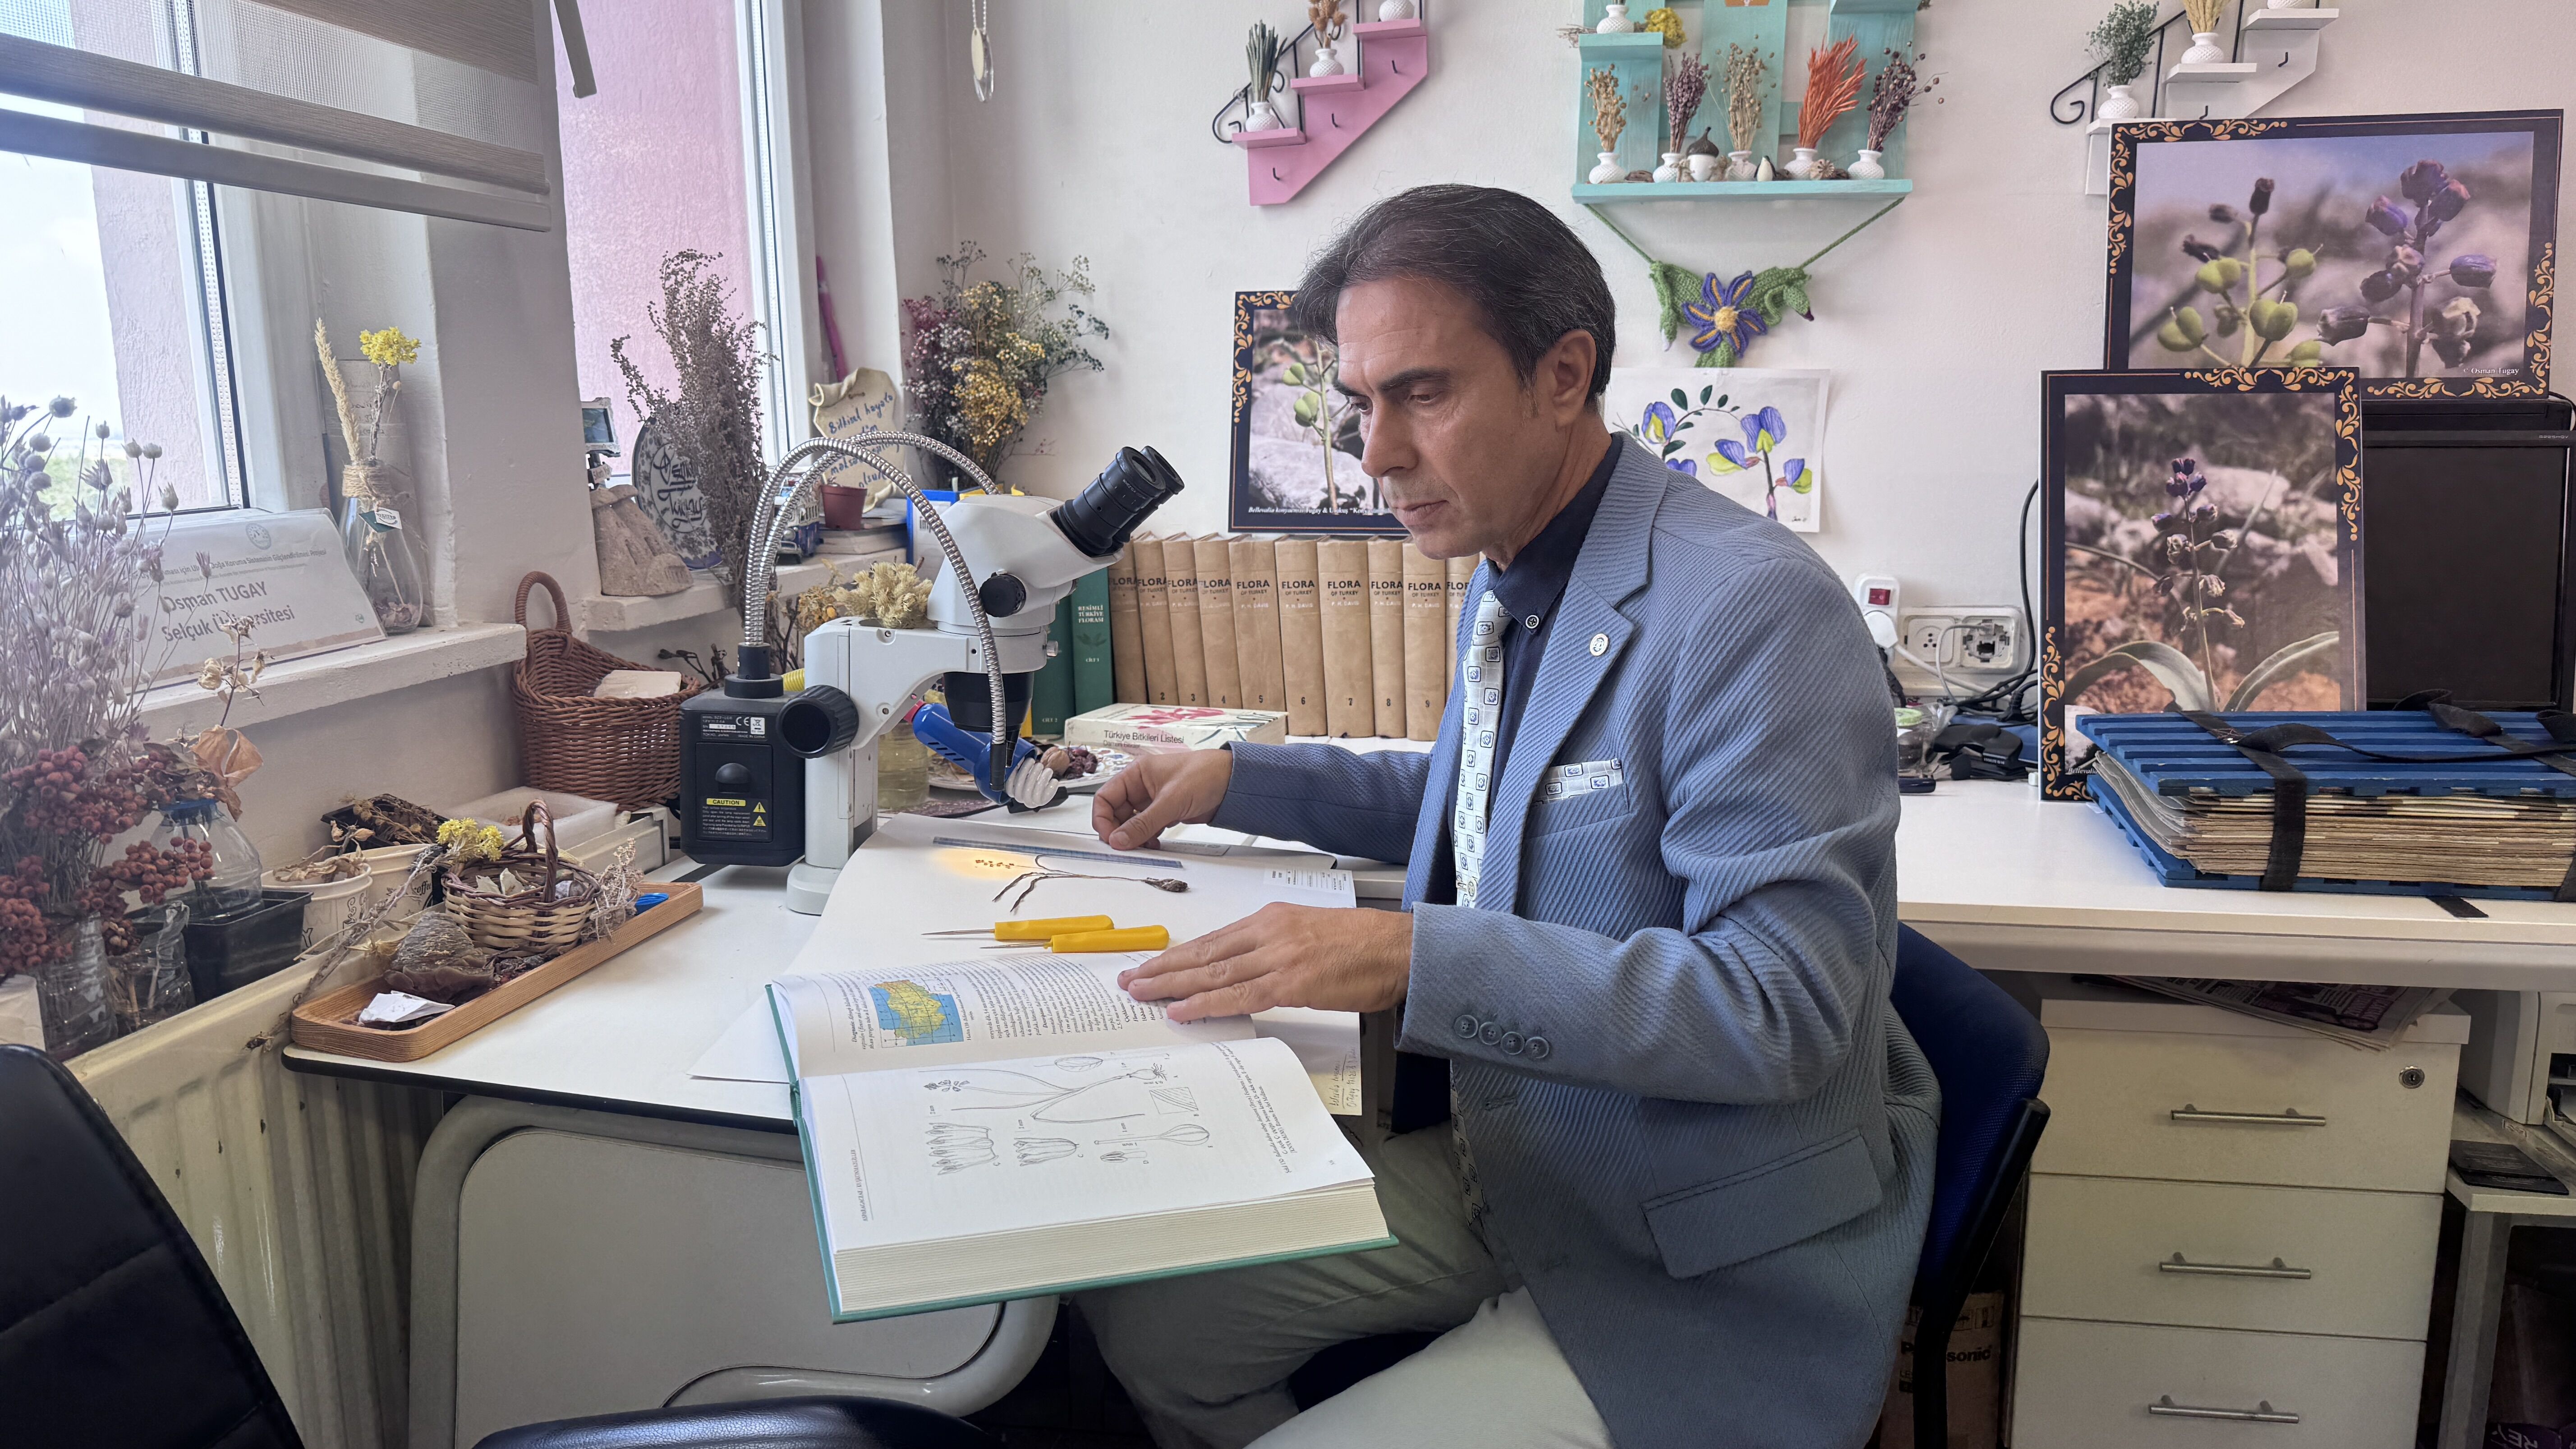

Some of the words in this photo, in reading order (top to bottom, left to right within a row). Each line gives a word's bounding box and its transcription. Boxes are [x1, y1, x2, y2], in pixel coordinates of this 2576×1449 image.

[1137, 577, 1167, 586] FLORA
[1167, 579, 1197, 588] FLORA
[1237, 580, 1270, 589] FLORA
[1282, 580, 1315, 589] FLORA
[1328, 580, 1361, 589] FLORA
[1371, 581, 1403, 589] FLORA
[1408, 582, 1441, 590] FLORA
[1447, 581, 1469, 589] FLOR
[163, 591, 218, 611] Osman
[216, 581, 267, 602] TUGAY
[161, 619, 214, 642] Selçuk
[1160, 692, 1165, 700] 2
[1191, 693, 1196, 701] 3
[1221, 695, 1226, 704] 4
[1259, 695, 1263, 703] 5
[1301, 697, 1306, 705] 6
[1104, 730, 1131, 741] Türkiye
[1132, 732, 1159, 742] Bitkileri
[1160, 735, 1184, 744] Listesi
[1901, 1341, 1991, 1362] Psonic
